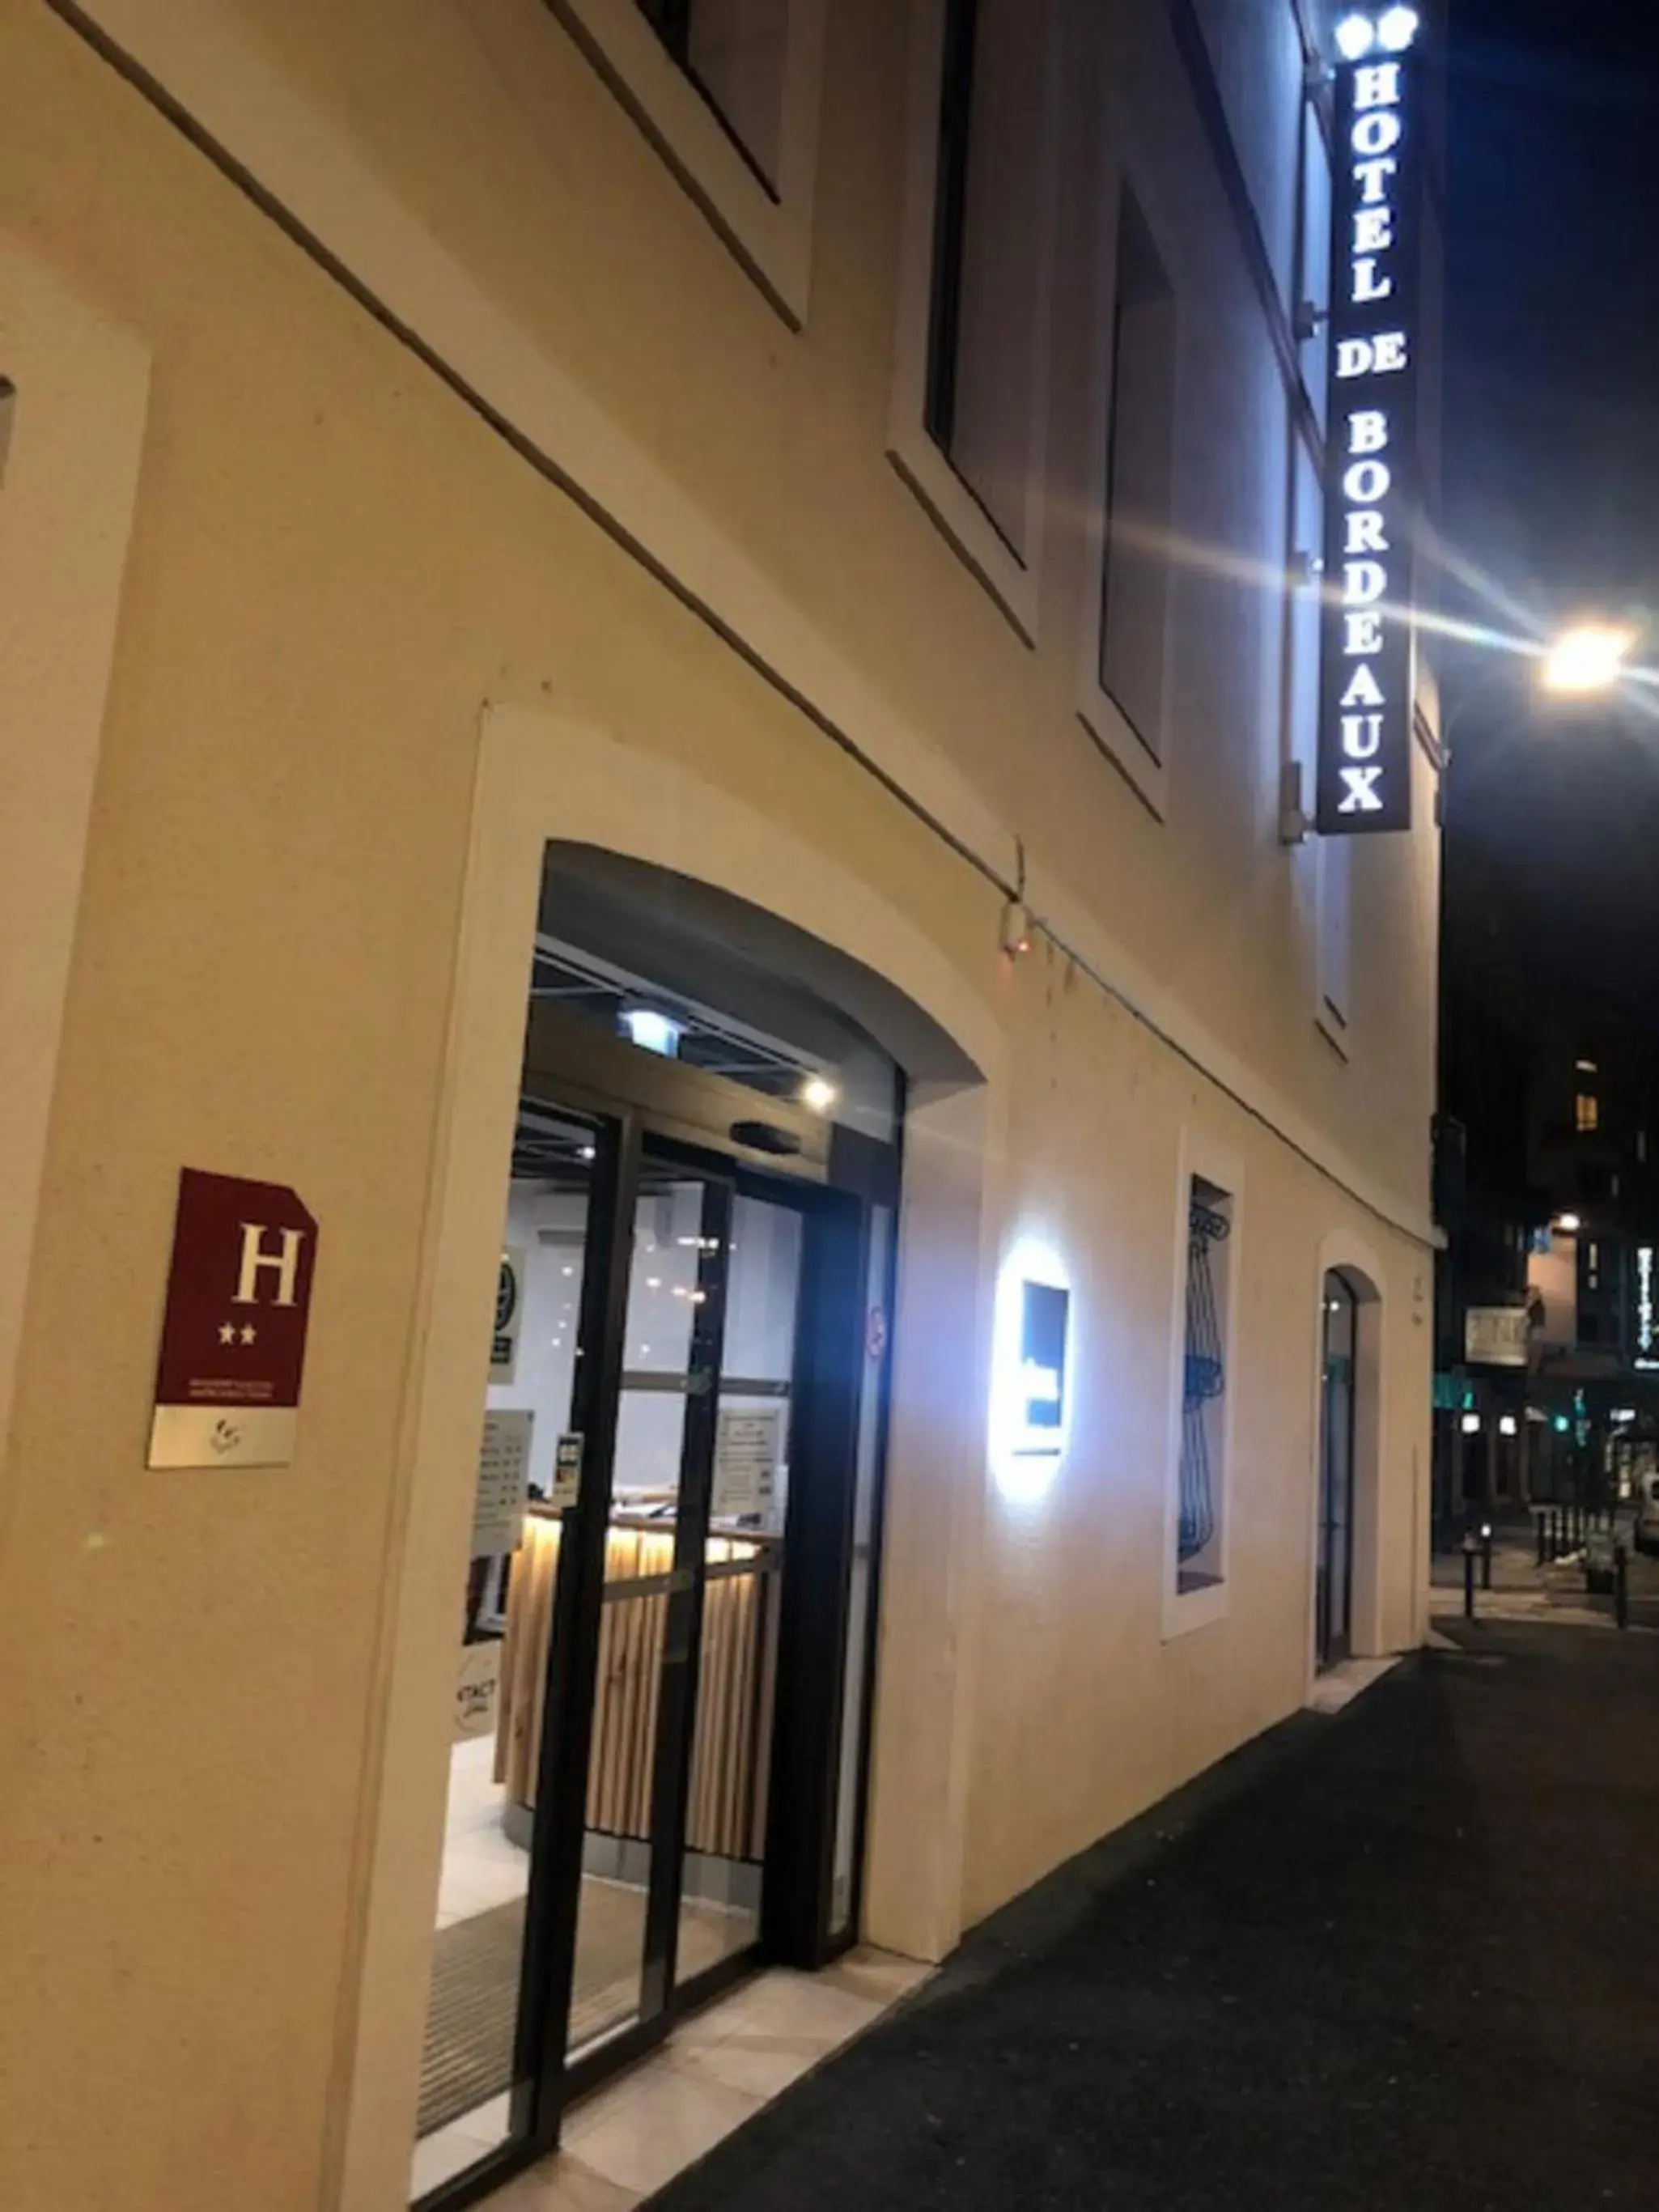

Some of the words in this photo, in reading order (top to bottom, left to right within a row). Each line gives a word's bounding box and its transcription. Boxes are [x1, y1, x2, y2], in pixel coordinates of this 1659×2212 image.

[1351, 62, 1401, 302] HOTEL
[1336, 332, 1407, 377] DE
[1336, 410, 1390, 812] BORDEAUX
[231, 1221, 305, 1306] H
